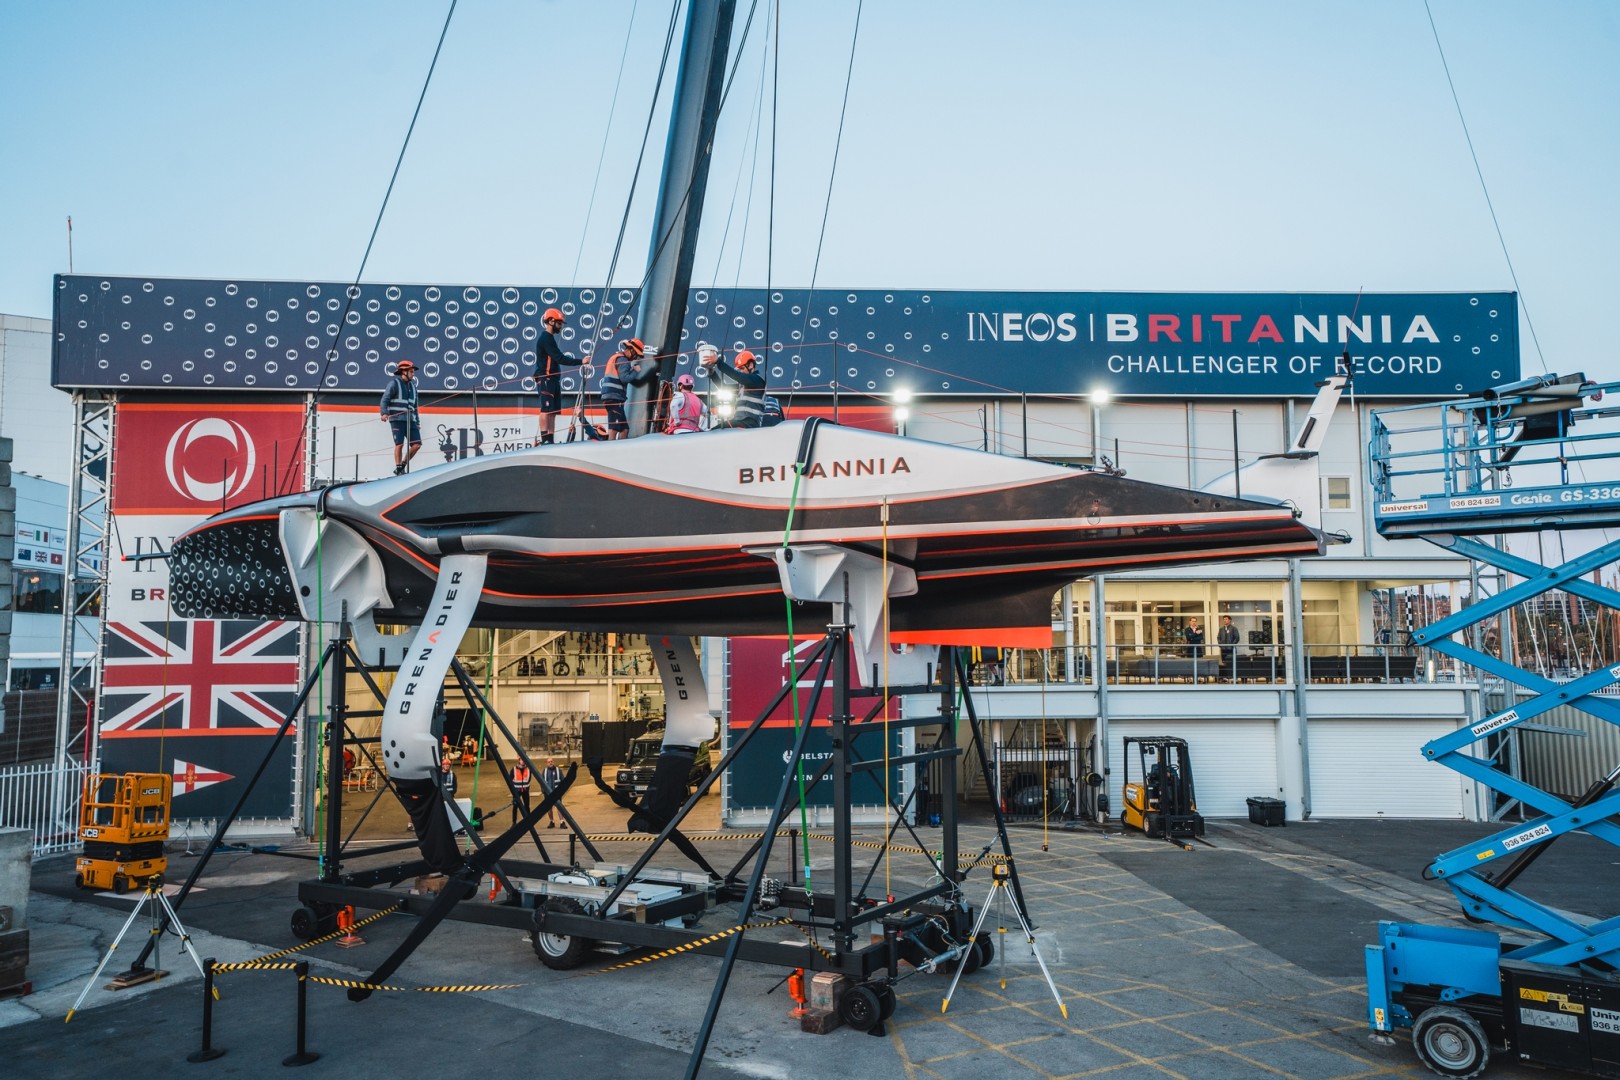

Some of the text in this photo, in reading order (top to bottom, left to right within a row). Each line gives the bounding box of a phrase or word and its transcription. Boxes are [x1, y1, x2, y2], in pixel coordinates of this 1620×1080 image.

[967, 312, 1440, 343] INEOS BRITANNIA
[1107, 355, 1278, 374] CHALLENGER
[1289, 355, 1322, 374] OF
[738, 456, 912, 485] BRIANNIA
[1450, 497, 1500, 508] 936 824 824
[1510, 493, 1553, 506] Genie
[1381, 503, 1427, 512] Universal
[1473, 712, 1518, 735] Universal
[143, 788, 160, 796] JCB
[81, 828, 99, 838] JCB
[1504, 826, 1550, 848] 936 824 824
[1592, 1020, 1611, 1030] 936
